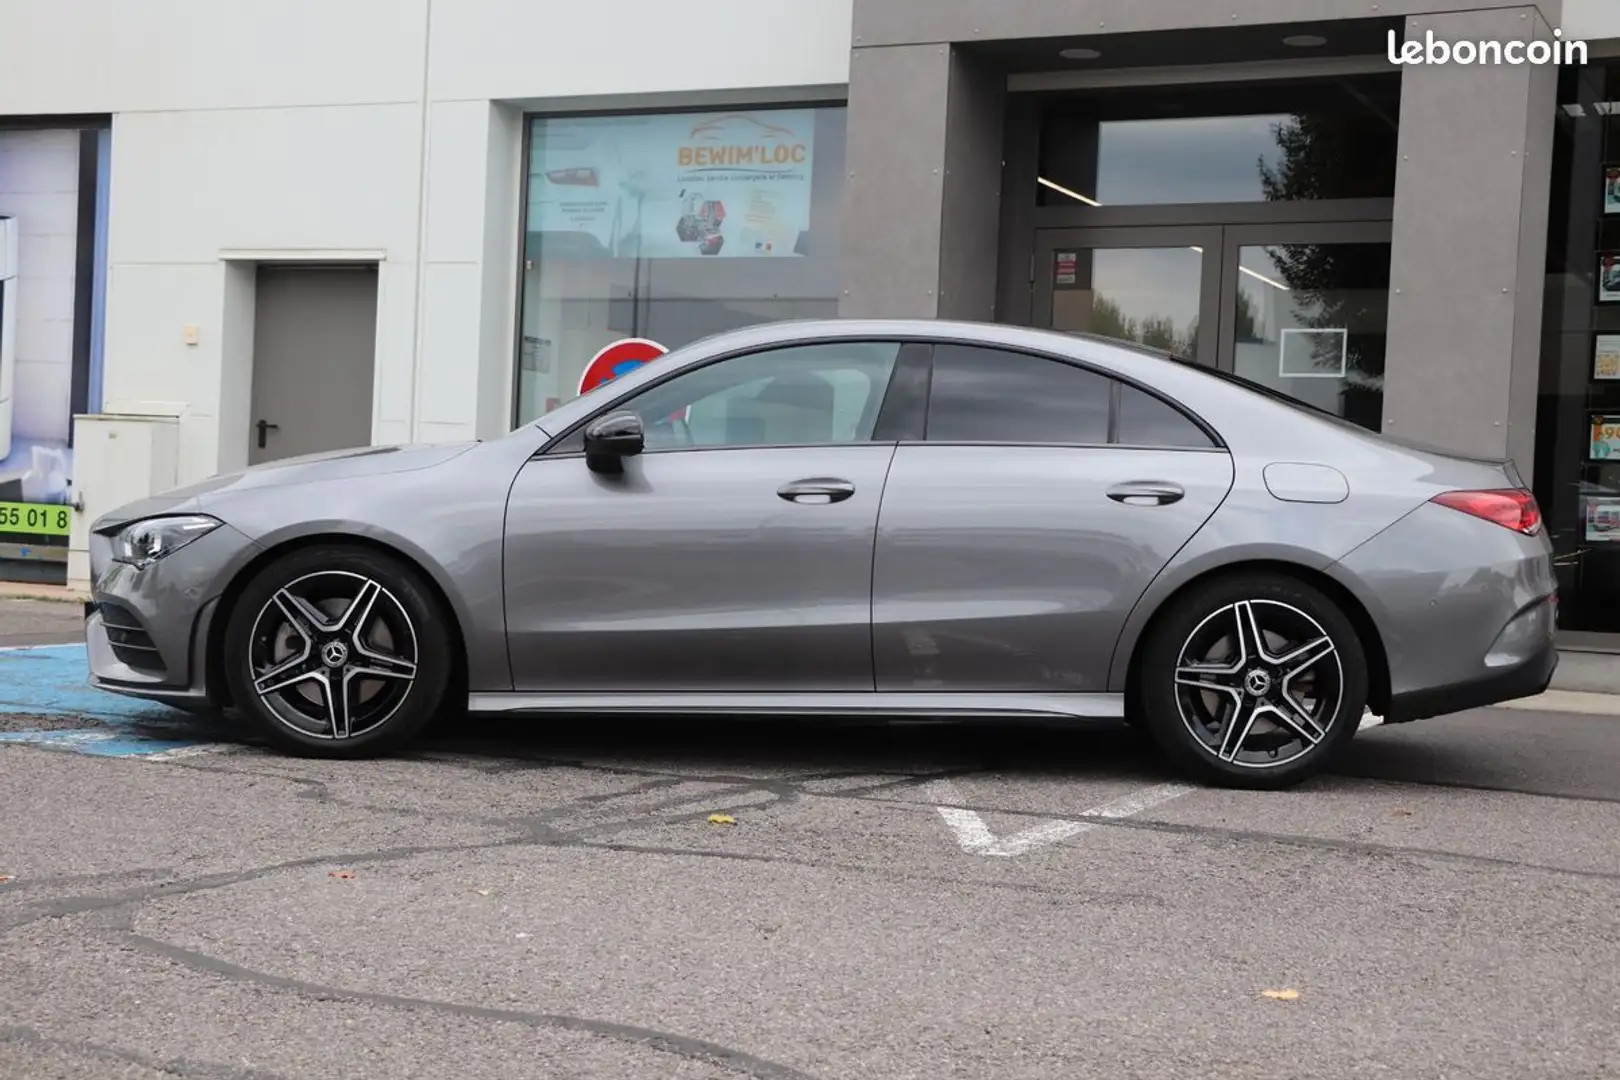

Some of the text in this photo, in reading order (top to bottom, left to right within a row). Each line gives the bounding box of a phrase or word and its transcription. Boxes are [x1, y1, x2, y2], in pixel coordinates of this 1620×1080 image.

[677, 144, 806, 166] BEWIM'LOC
[0, 507, 20, 526] 55
[27, 508, 48, 528] 01
